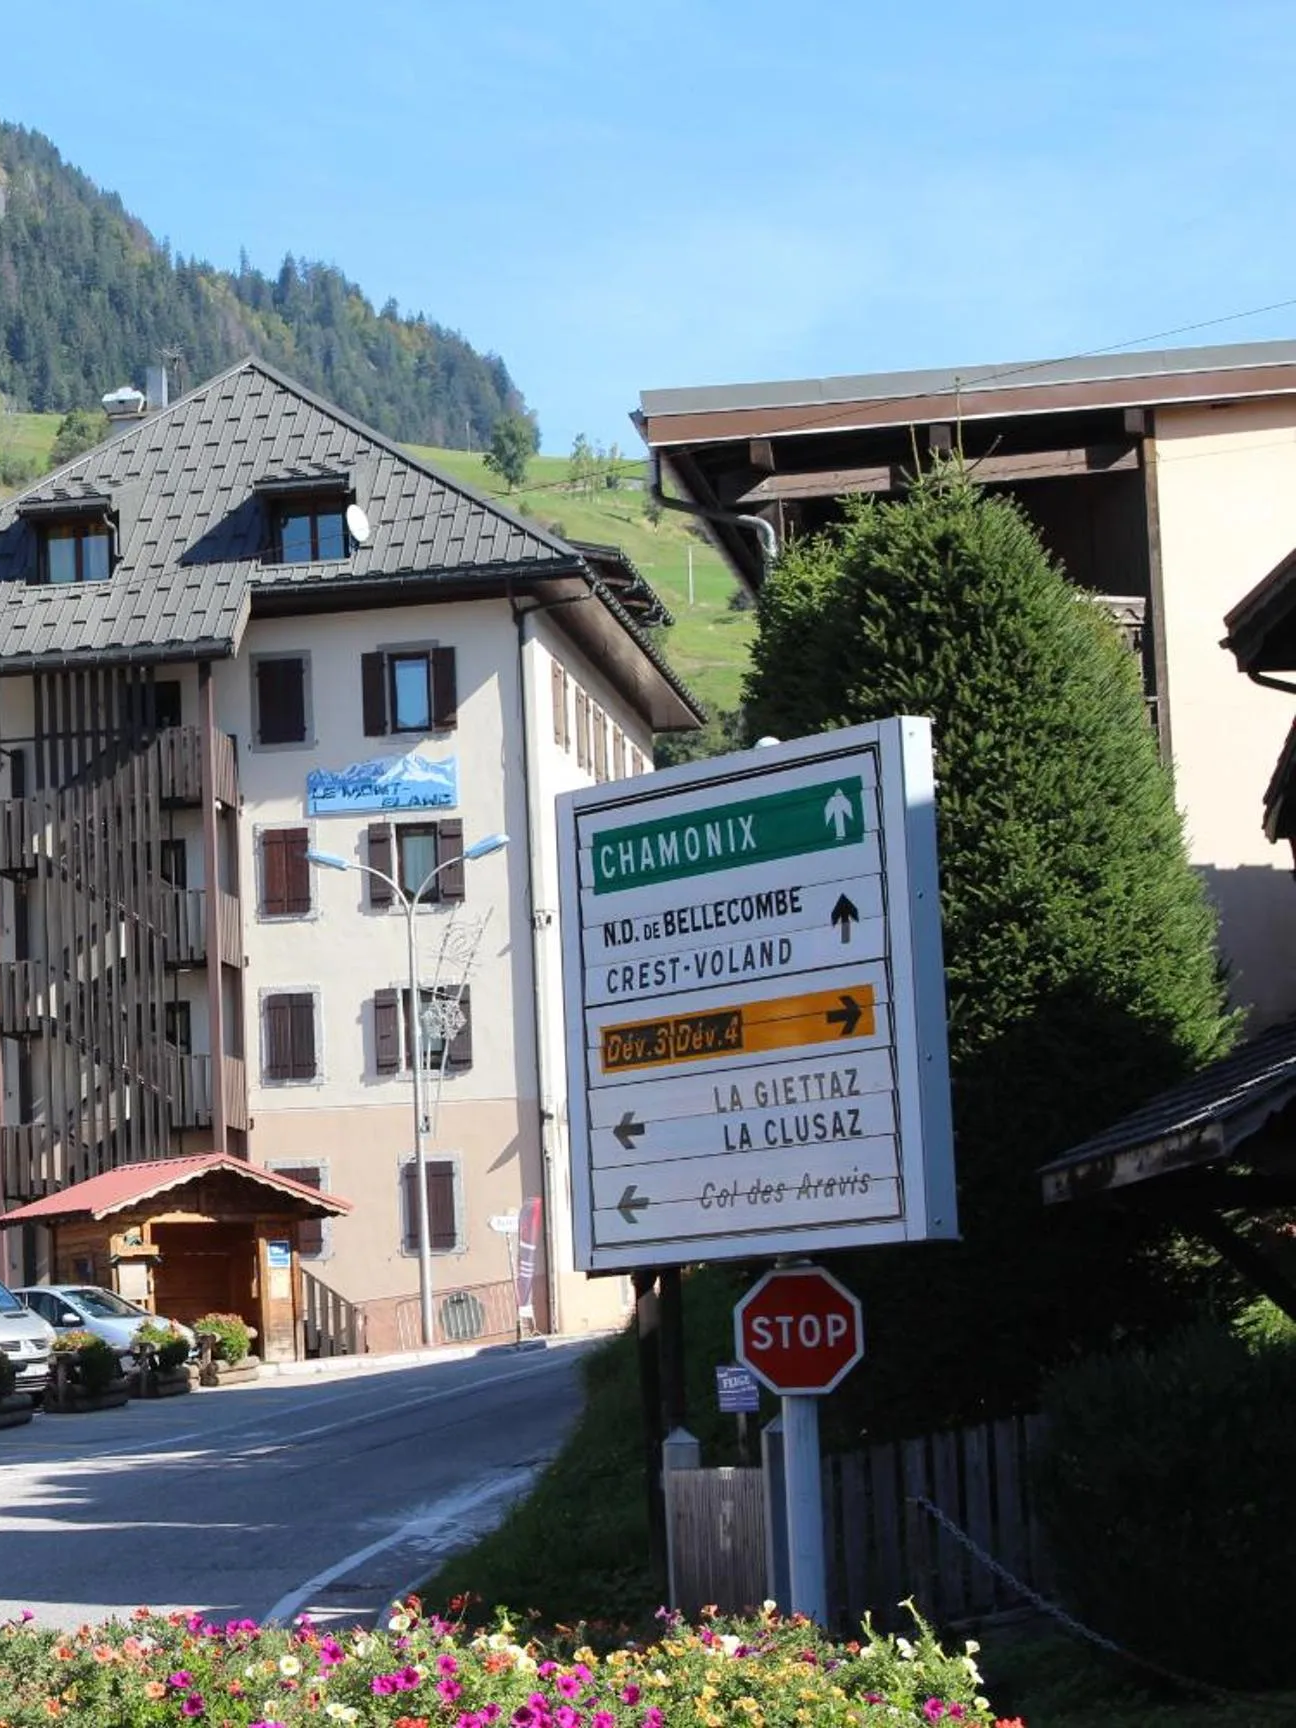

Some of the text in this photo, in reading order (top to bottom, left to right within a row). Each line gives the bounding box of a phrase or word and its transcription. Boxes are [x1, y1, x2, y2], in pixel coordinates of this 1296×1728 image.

[600, 814, 757, 879] CHAMONIX
[603, 919, 640, 948] N.D.
[663, 886, 803, 937] BELLECOMBE
[607, 938, 793, 994] CREST-VOLAND
[713, 1068, 861, 1114] LA GIETTAZ
[723, 1108, 863, 1151] LA CLUSAZ
[701, 1166, 872, 1209] Col des Aravis
[751, 1314, 848, 1350] STOP
